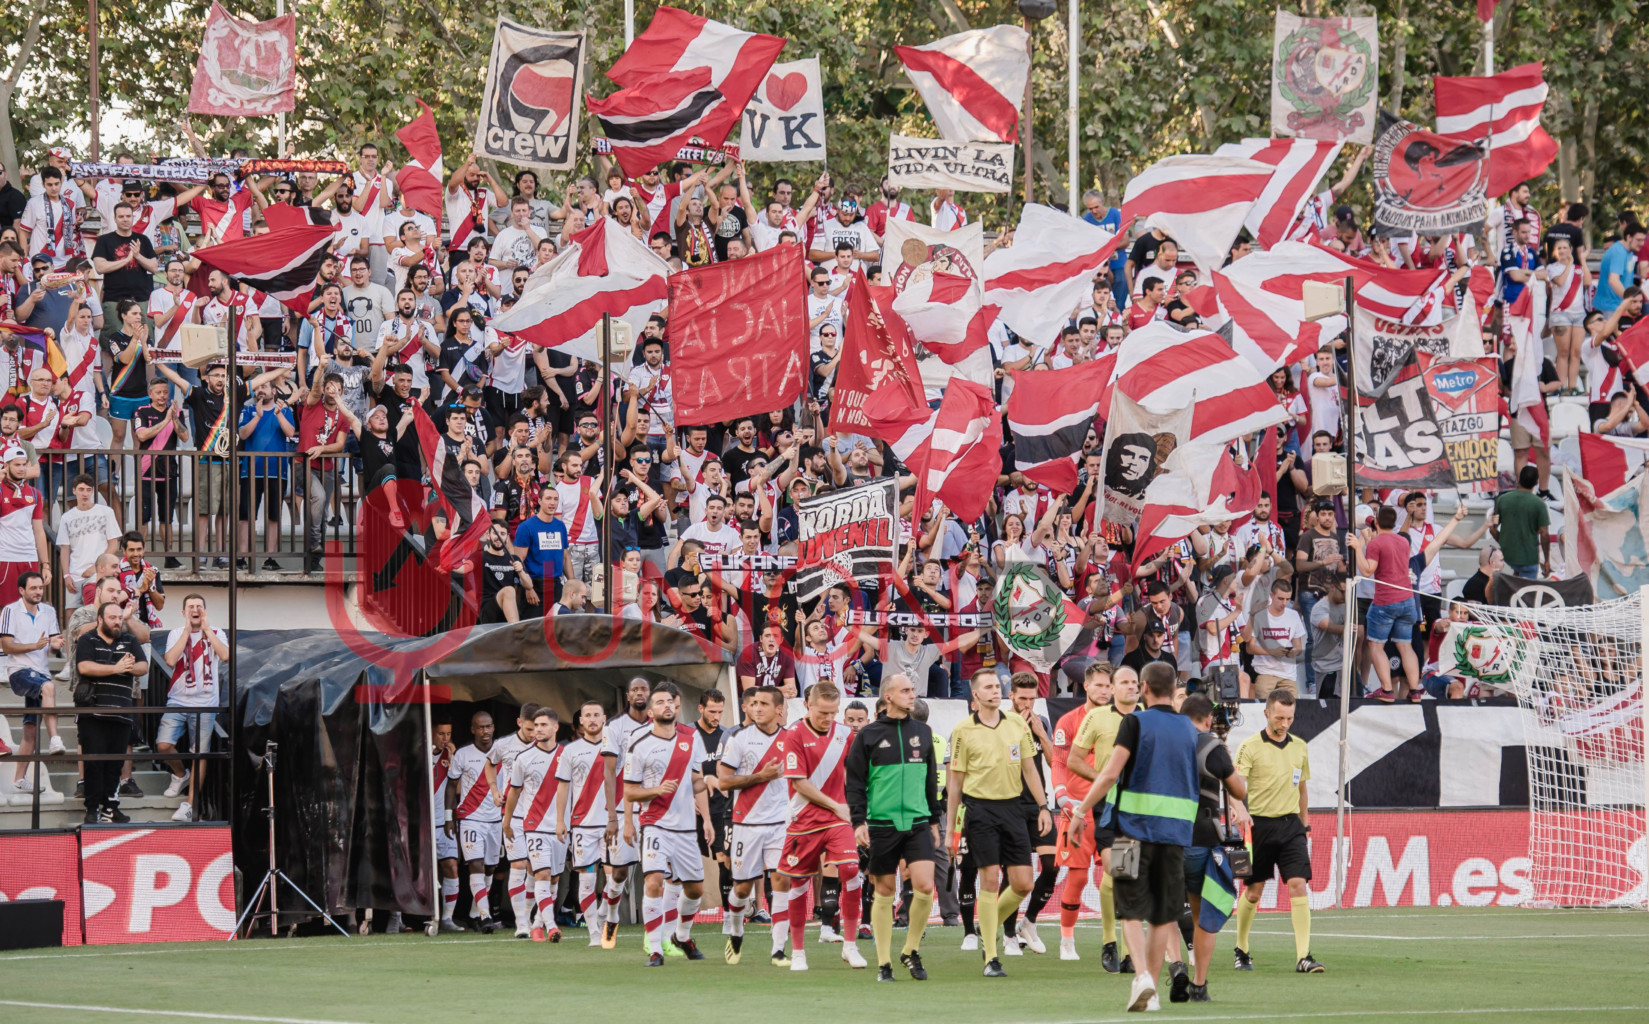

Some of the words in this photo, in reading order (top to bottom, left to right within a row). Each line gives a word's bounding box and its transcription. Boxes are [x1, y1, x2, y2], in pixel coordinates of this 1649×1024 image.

[487, 126, 567, 158] crew
[890, 162, 939, 175] VIDA
[943, 163, 1011, 187] ULTRA
[1413, 214, 1439, 228] PARA
[1436, 374, 1474, 391] Metro
[800, 489, 885, 541] KORDA
[798, 517, 893, 567] JUVENIL
[847, 611, 993, 628] BUKANEROS
[1263, 629, 1290, 637] ULTRAS
[463, 830, 477, 843] 10
[528, 838, 543, 851] 22
[575, 833, 583, 847] 2
[646, 837, 660, 851] 16
[735, 841, 744, 857] 8
